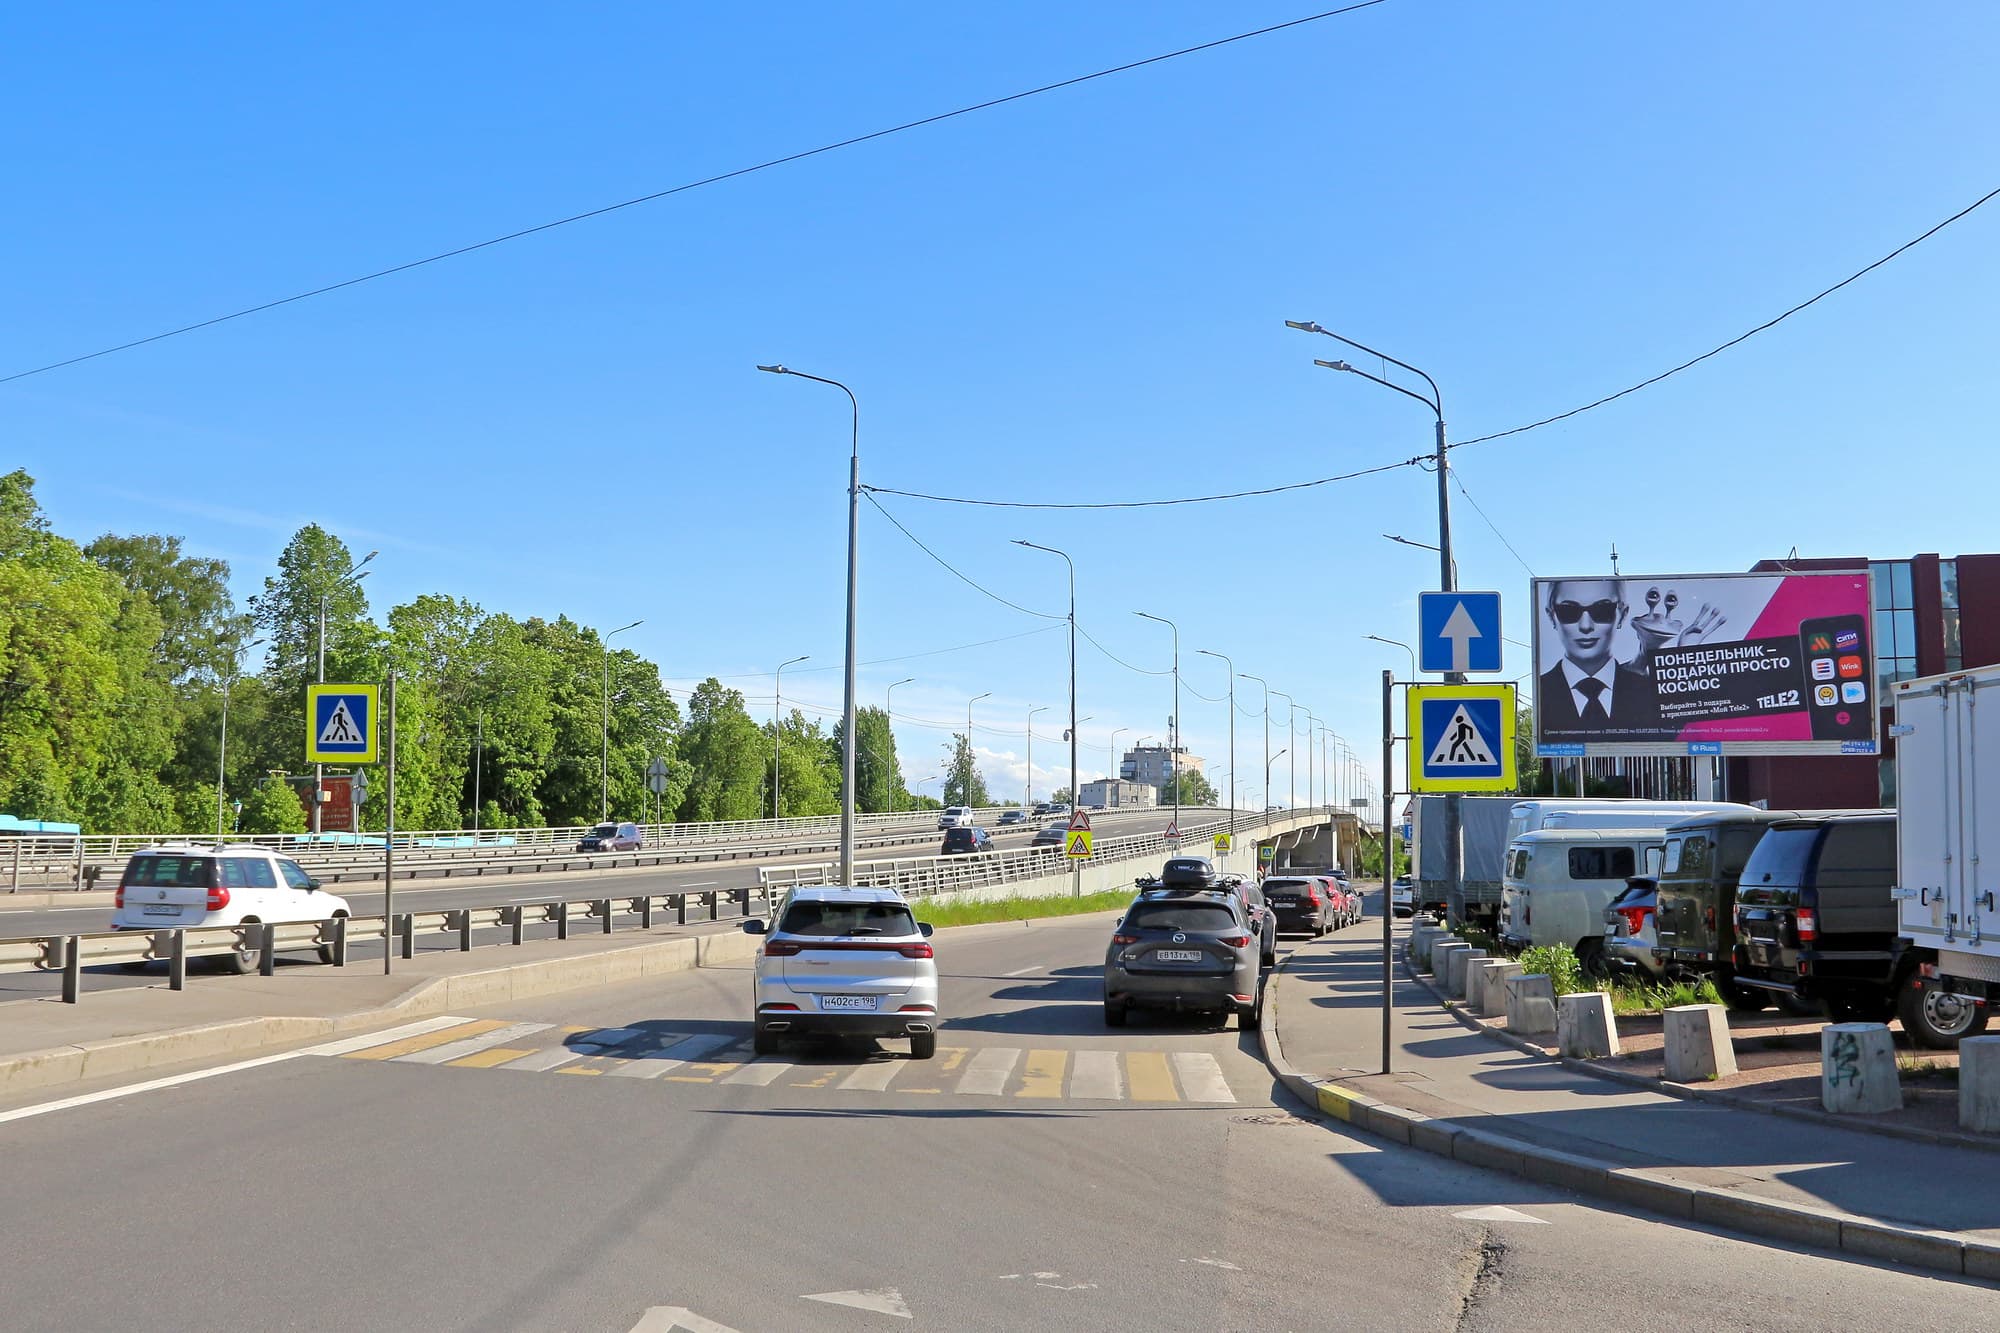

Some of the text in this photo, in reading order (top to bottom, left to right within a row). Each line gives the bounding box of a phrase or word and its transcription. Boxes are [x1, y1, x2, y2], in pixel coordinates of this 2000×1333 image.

[1655, 645, 1764, 666] ПОНЕДЕЛЬНИК
[1656, 656, 1790, 681] ПОДАРКИ ПРОСТО
[1841, 663, 1859, 671] Wink
[1657, 677, 1721, 695] КОСМОС
[1660, 702, 1697, 711] Выбирайте
[1703, 699, 1731, 707] подарка
[1756, 689, 1800, 709] TELE2
[1699, 744, 1718, 752] Russ
